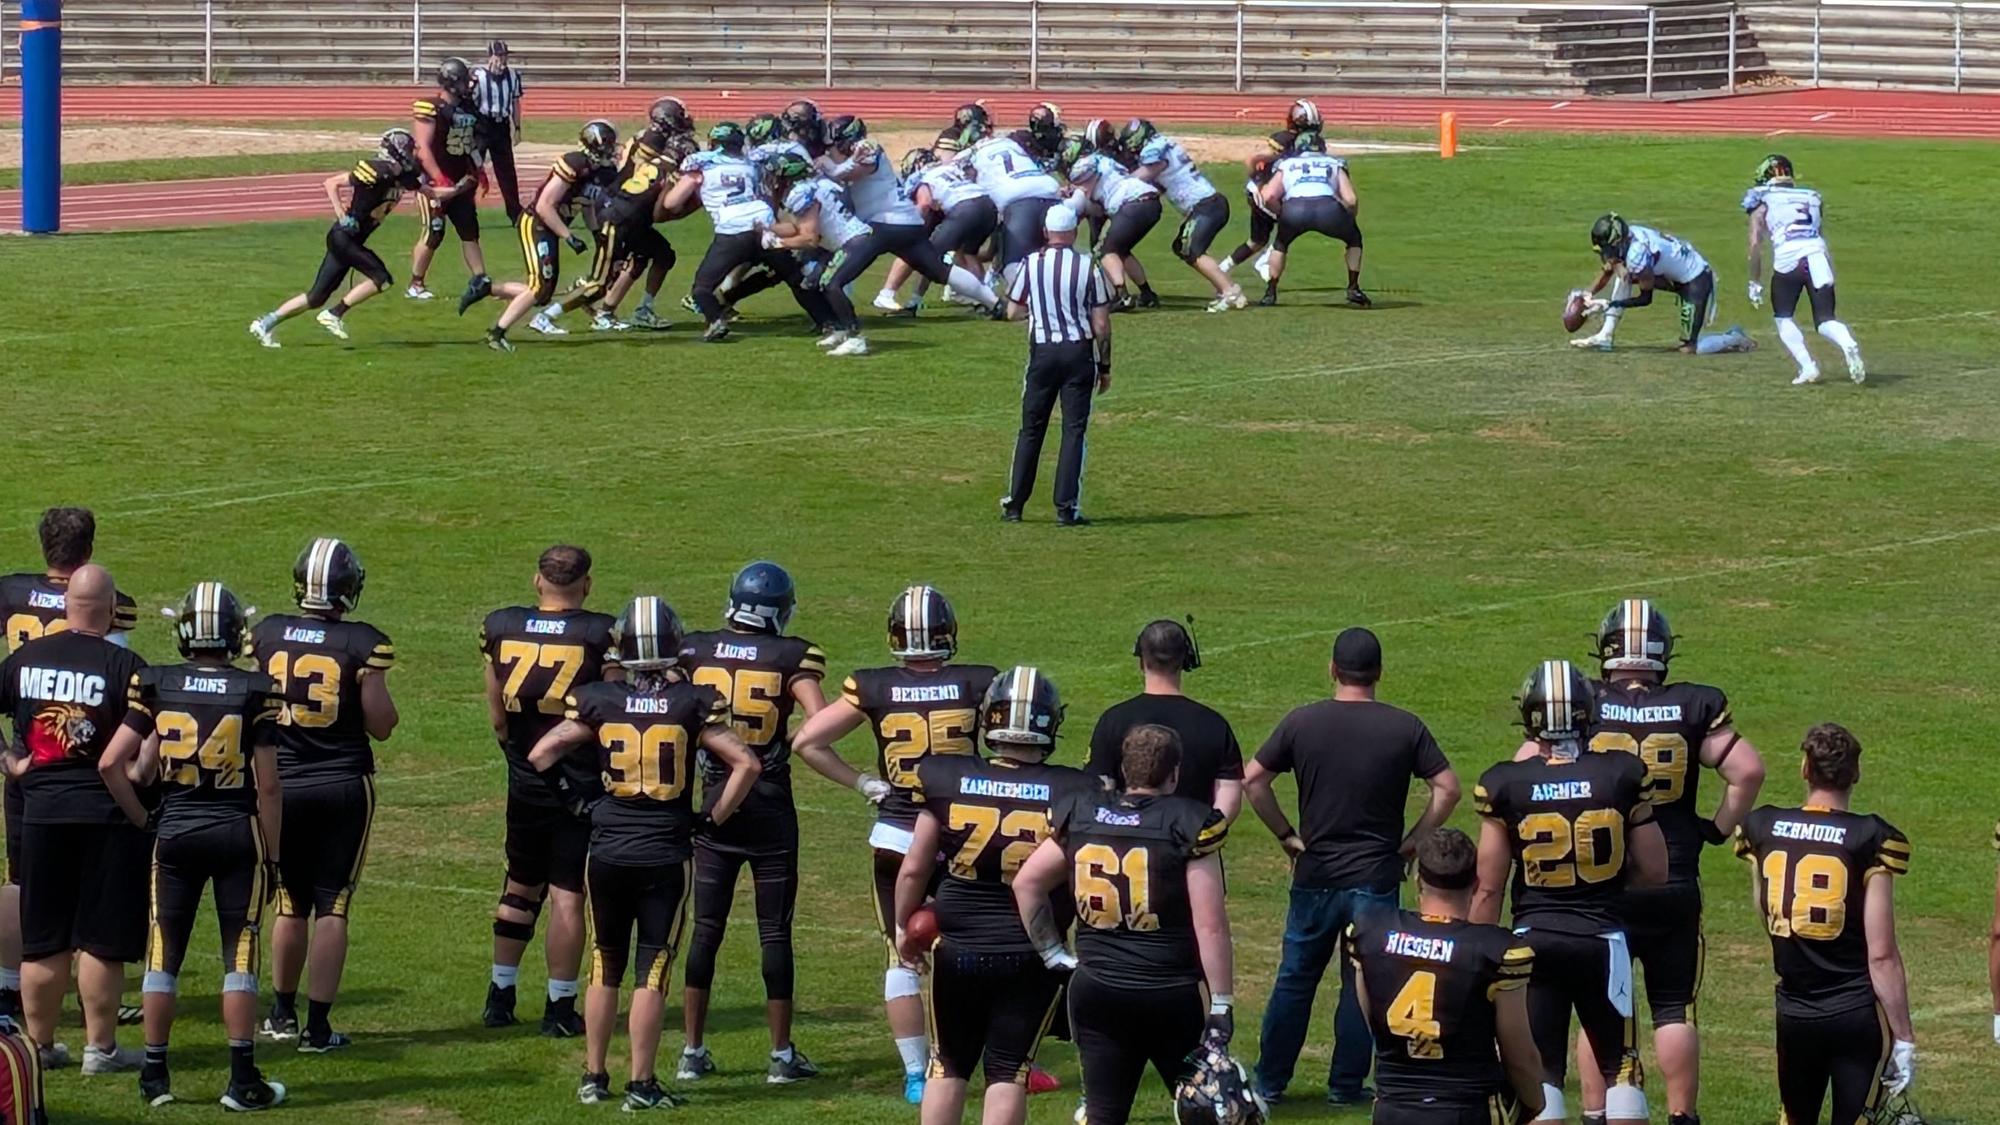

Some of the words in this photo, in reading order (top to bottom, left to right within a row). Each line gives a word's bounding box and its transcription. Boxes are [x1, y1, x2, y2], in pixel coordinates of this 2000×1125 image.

[1788, 201, 1813, 225] 3
[525, 619, 567, 635] LIONS
[714, 643, 757, 661] LIONS
[20, 666, 105, 706] MEDIC
[183, 676, 227, 694] LIONS
[267, 651, 341, 727] 13
[500, 640, 584, 716] 77
[625, 696, 668, 713] LIONS
[1601, 703, 1682, 723] SOMMERER
[156, 711, 244, 789] 24
[599, 723, 687, 801] 30
[880, 708, 976, 788] 25
[1531, 781, 1592, 801] AIGNER
[949, 803, 1048, 885] 72
[1518, 808, 1625, 887] 20
[1772, 821, 1847, 845] SCHMUDE
[1075, 844, 1160, 931] 61
[1763, 850, 1848, 940] 18
[1386, 971, 1444, 1059] 4
